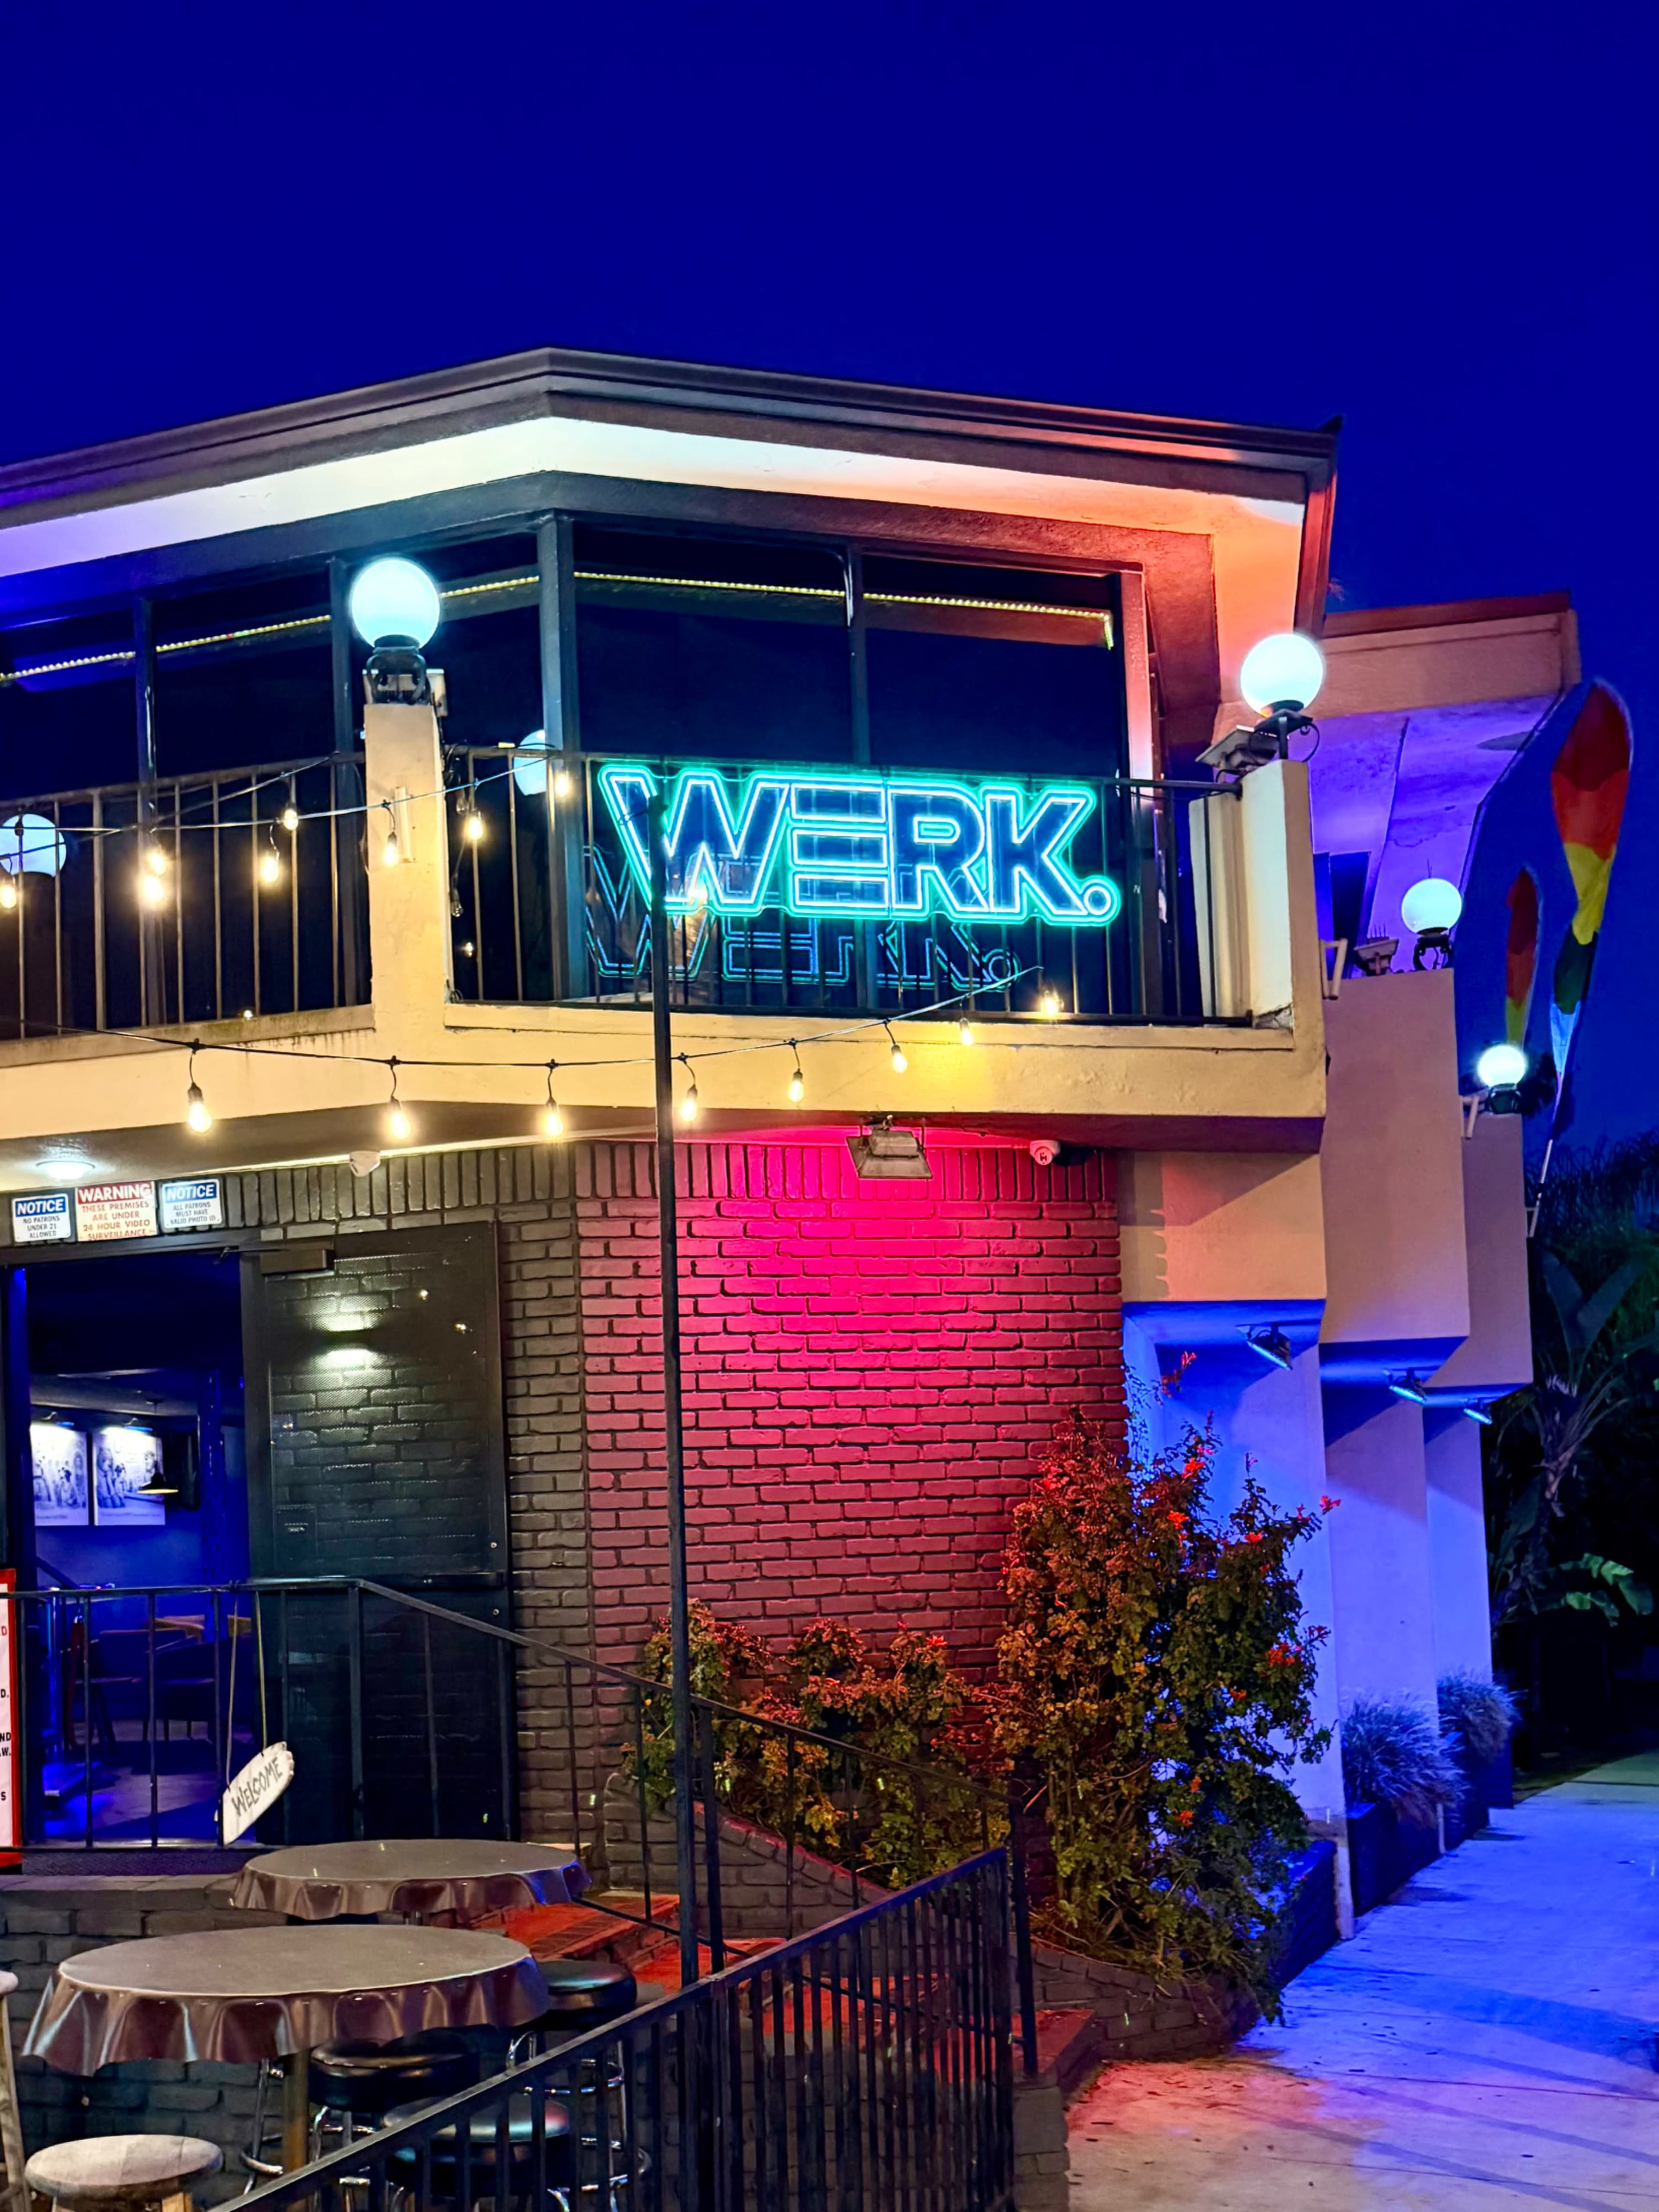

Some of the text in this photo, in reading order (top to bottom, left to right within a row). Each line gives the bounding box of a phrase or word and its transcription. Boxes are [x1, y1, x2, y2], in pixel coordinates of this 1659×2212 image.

[600, 766, 1121, 926] WERK.
[79, 1183, 151, 1203] WARNING
[167, 1184, 215, 1201] NOTICE
[18, 1199, 64, 1215] NOTICE
[82, 1201, 149, 1213] THESE PREMISES
[112, 1211, 140, 1219] UNDER
[27, 1224, 47, 1232] UNDER
[97, 1221, 121, 1230] HOUR
[124, 1219, 150, 1228] VIDEO
[29, 1230, 56, 1239] ALLOWED
[88, 1229, 146, 1241] SURVEILLANCE
[231, 1757, 283, 1817] WELCOME
